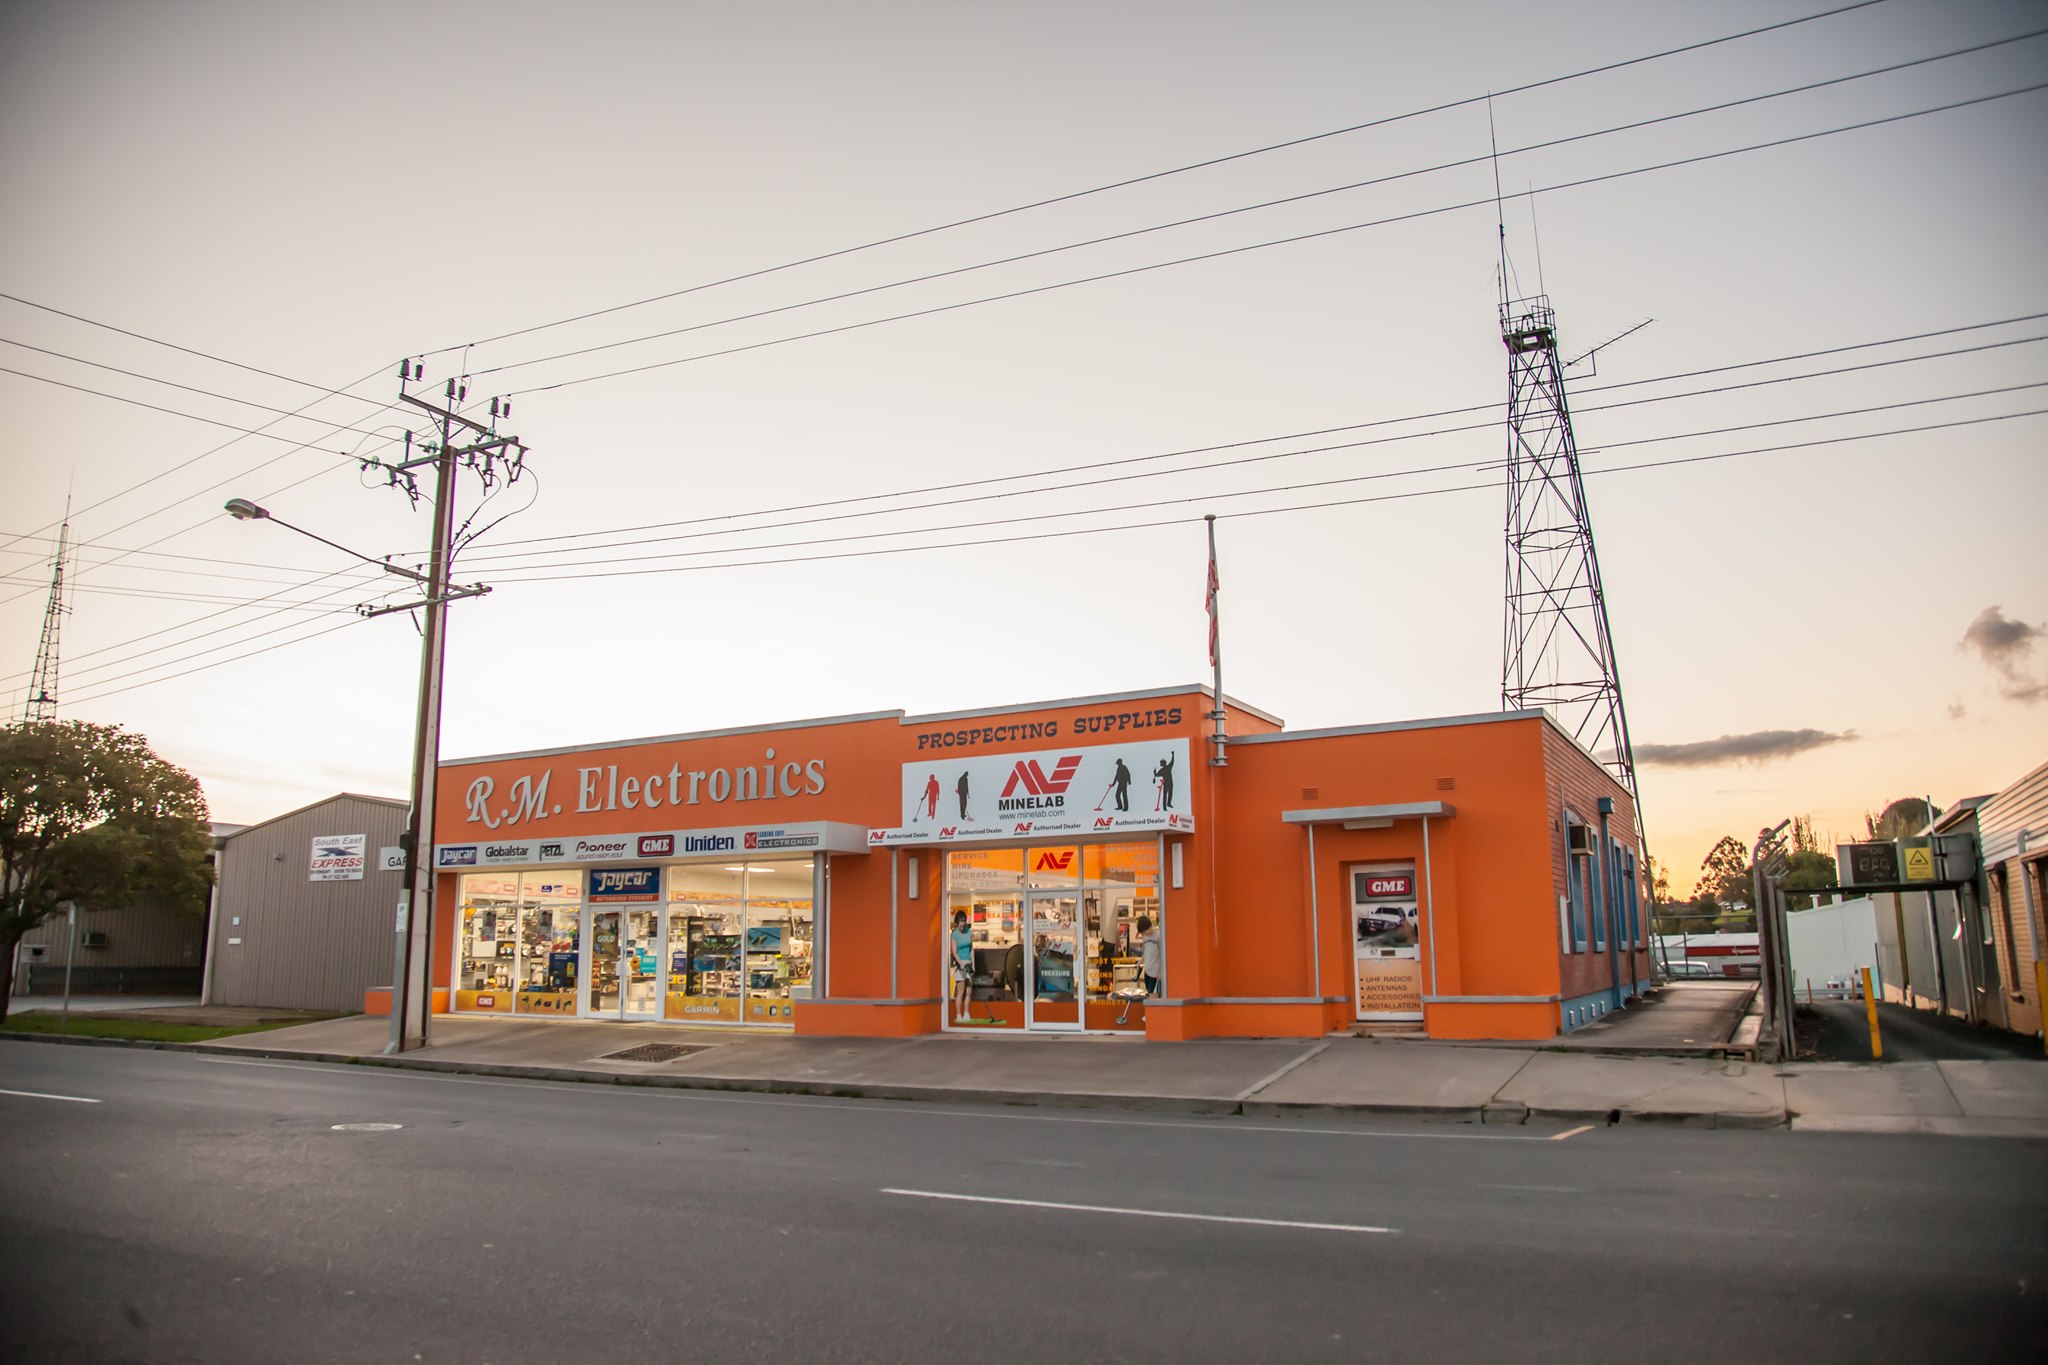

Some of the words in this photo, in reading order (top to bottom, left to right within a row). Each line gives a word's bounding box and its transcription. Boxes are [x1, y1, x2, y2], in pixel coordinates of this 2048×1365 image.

[917, 721, 1058, 749] PROSPECTING
[1073, 708, 1182, 734] SUPPLIES
[466, 768, 562, 829] R.M.
[575, 748, 825, 813] Electronics
[998, 795, 1064, 811] MINELAB
[998, 809, 1066, 820] www.minelab.com
[315, 838, 340, 846] South
[342, 836, 362, 845] East
[576, 841, 627, 852] Pioneer
[642, 839, 670, 853] GME
[685, 835, 735, 852] Uniden
[758, 837, 818, 848] ELECTRONICS
[441, 848, 476, 863] Jaycar
[485, 845, 529, 857] Globalstar
[952, 852, 988, 860] SERVICE
[311, 857, 363, 868] EXPRESS
[597, 872, 652, 891] Jaycar
[1371, 880, 1405, 893] GME
[597, 935, 615, 943] GOLD
[1040, 969, 1071, 977] TREASURE
[684, 1005, 719, 1014] GARMIN
